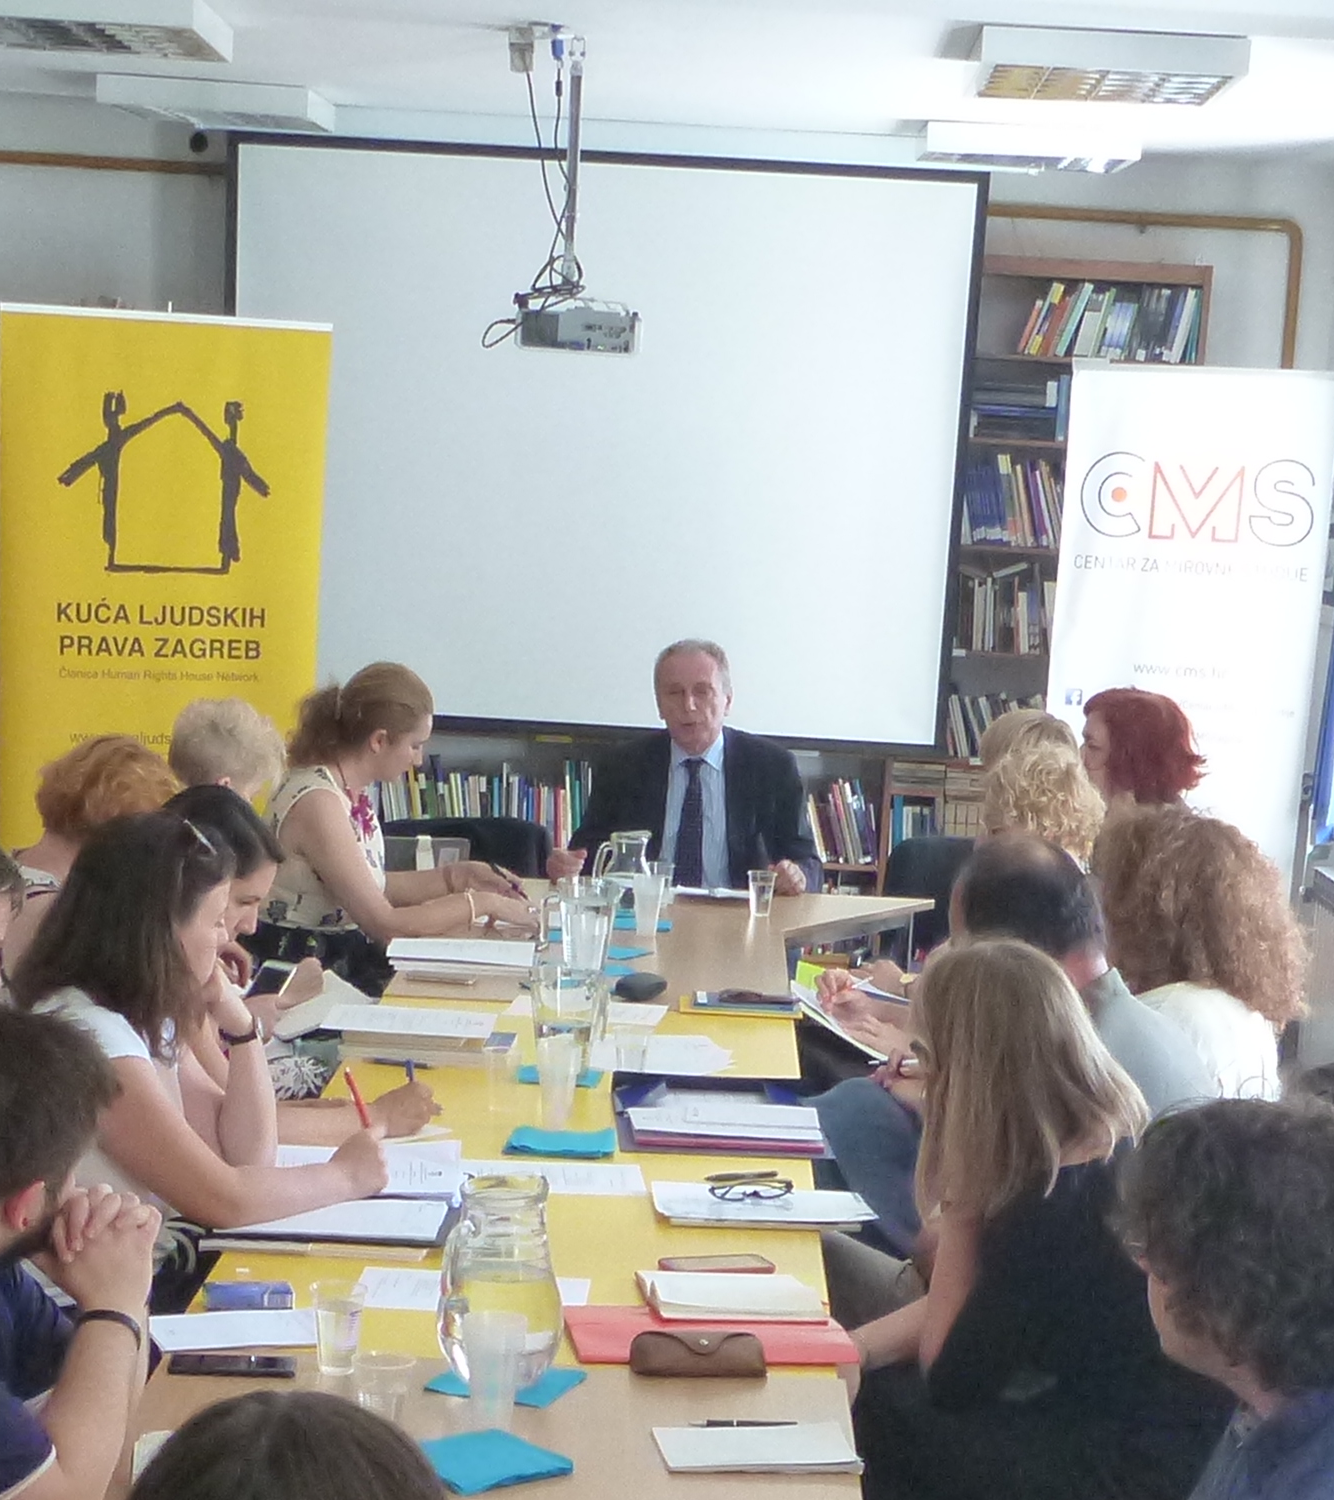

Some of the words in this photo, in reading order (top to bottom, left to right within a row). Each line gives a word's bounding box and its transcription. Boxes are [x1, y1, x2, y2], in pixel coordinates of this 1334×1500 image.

[1080, 451, 1317, 547] CMS
[1140, 557, 1160, 573] ZA
[56, 598, 131, 625] KUĆA
[138, 604, 266, 628] LJUDSKIH
[58, 635, 146, 657] PRAVA
[153, 637, 262, 660] ZAGREB
[101, 668, 140, 681] Human
[143, 669, 178, 683] Rights
[180, 670, 214, 681] House
[216, 671, 260, 683] Network
